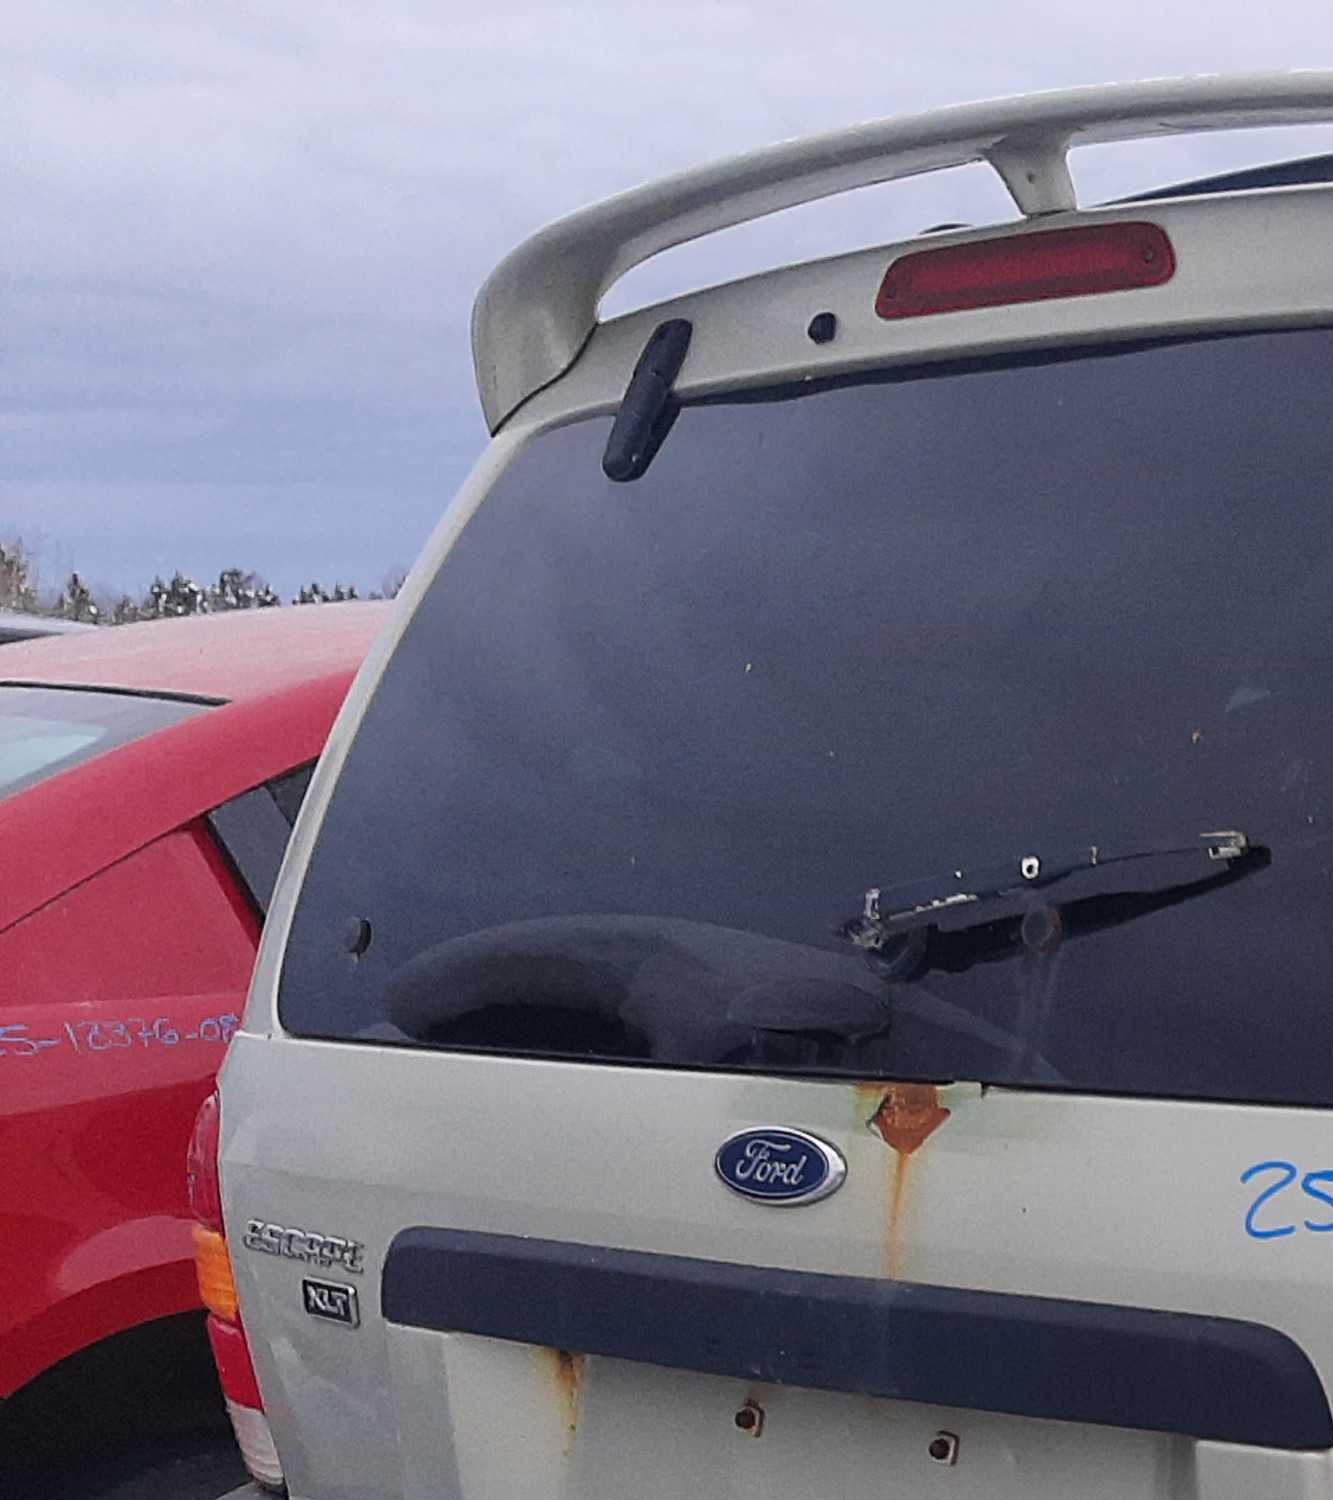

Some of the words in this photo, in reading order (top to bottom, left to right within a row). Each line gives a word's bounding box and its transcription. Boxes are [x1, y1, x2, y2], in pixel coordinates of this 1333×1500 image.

[735, 1138, 808, 1185] Ford
[243, 1219, 364, 1274] ESCAPE
[305, 1284, 349, 1316] XLT
